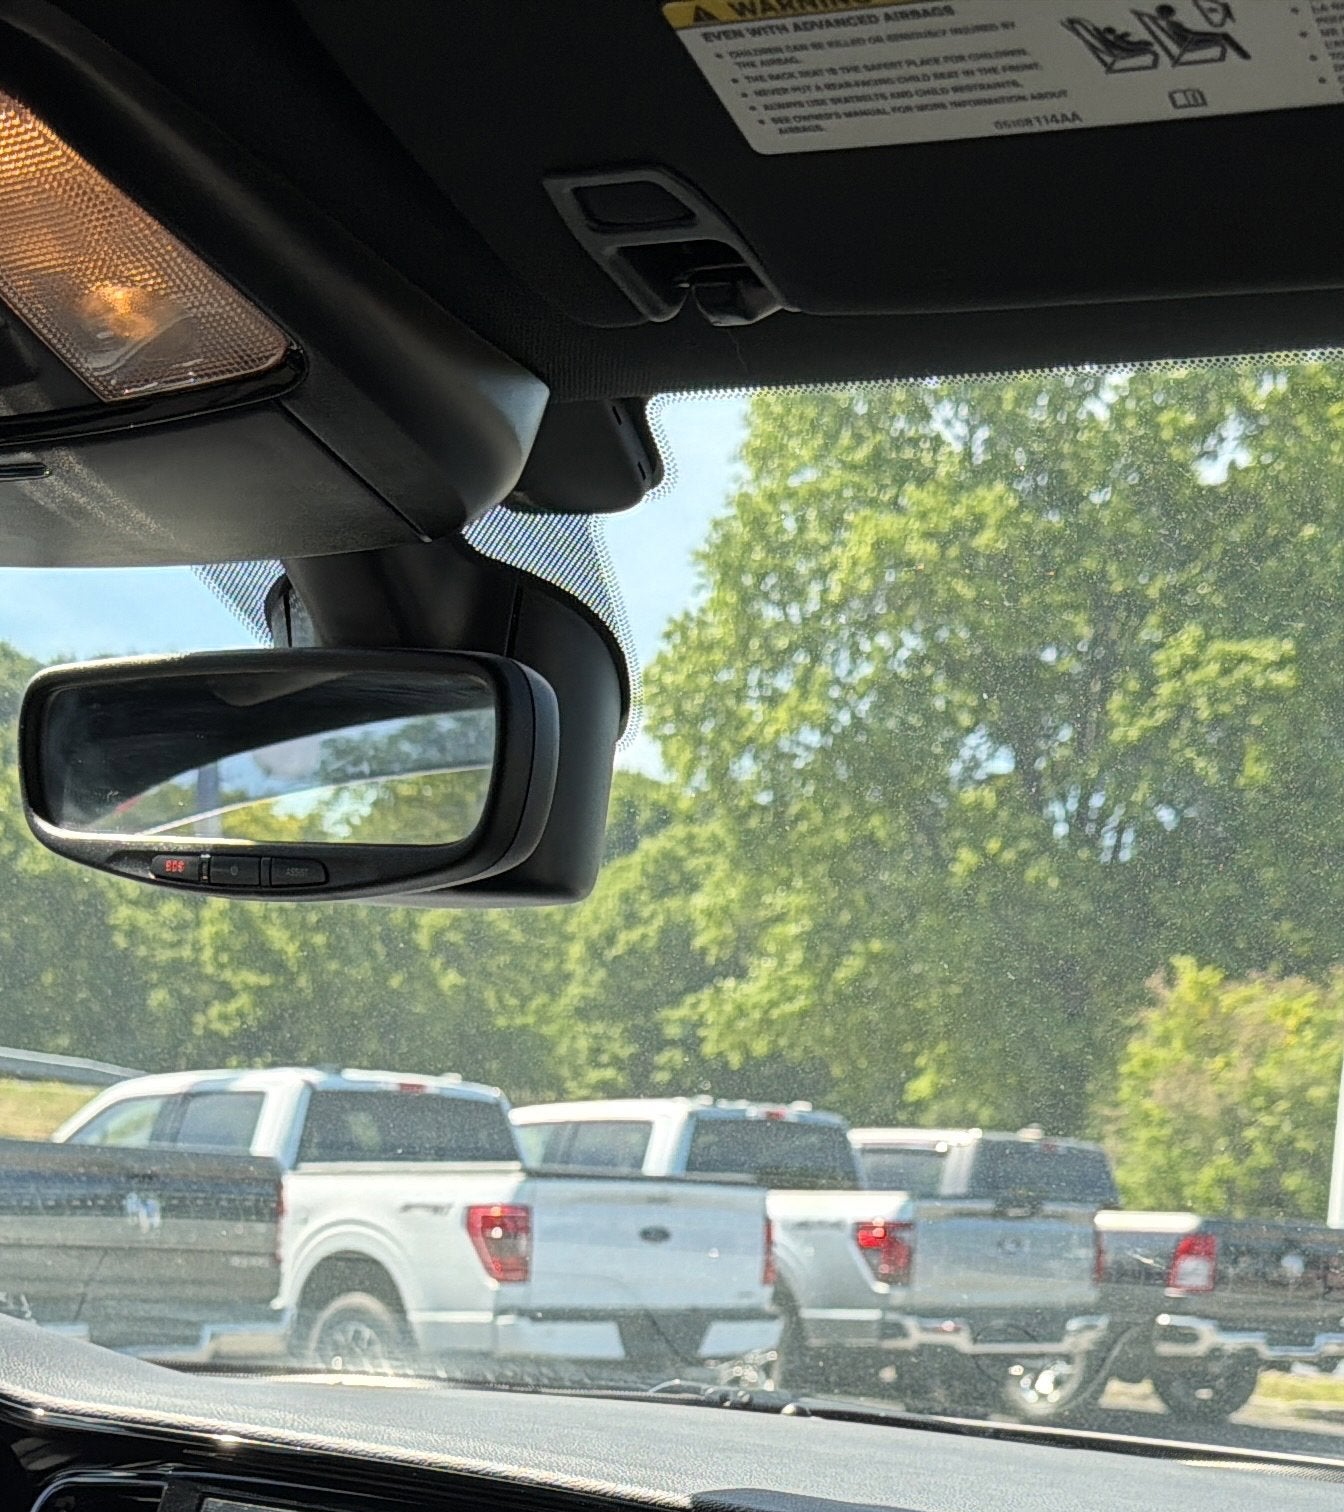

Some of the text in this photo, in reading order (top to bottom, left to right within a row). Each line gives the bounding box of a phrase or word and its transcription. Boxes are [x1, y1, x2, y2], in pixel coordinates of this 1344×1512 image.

[702, 5, 955, 42] EVEN WITH ADVANCED AIRBAGS
